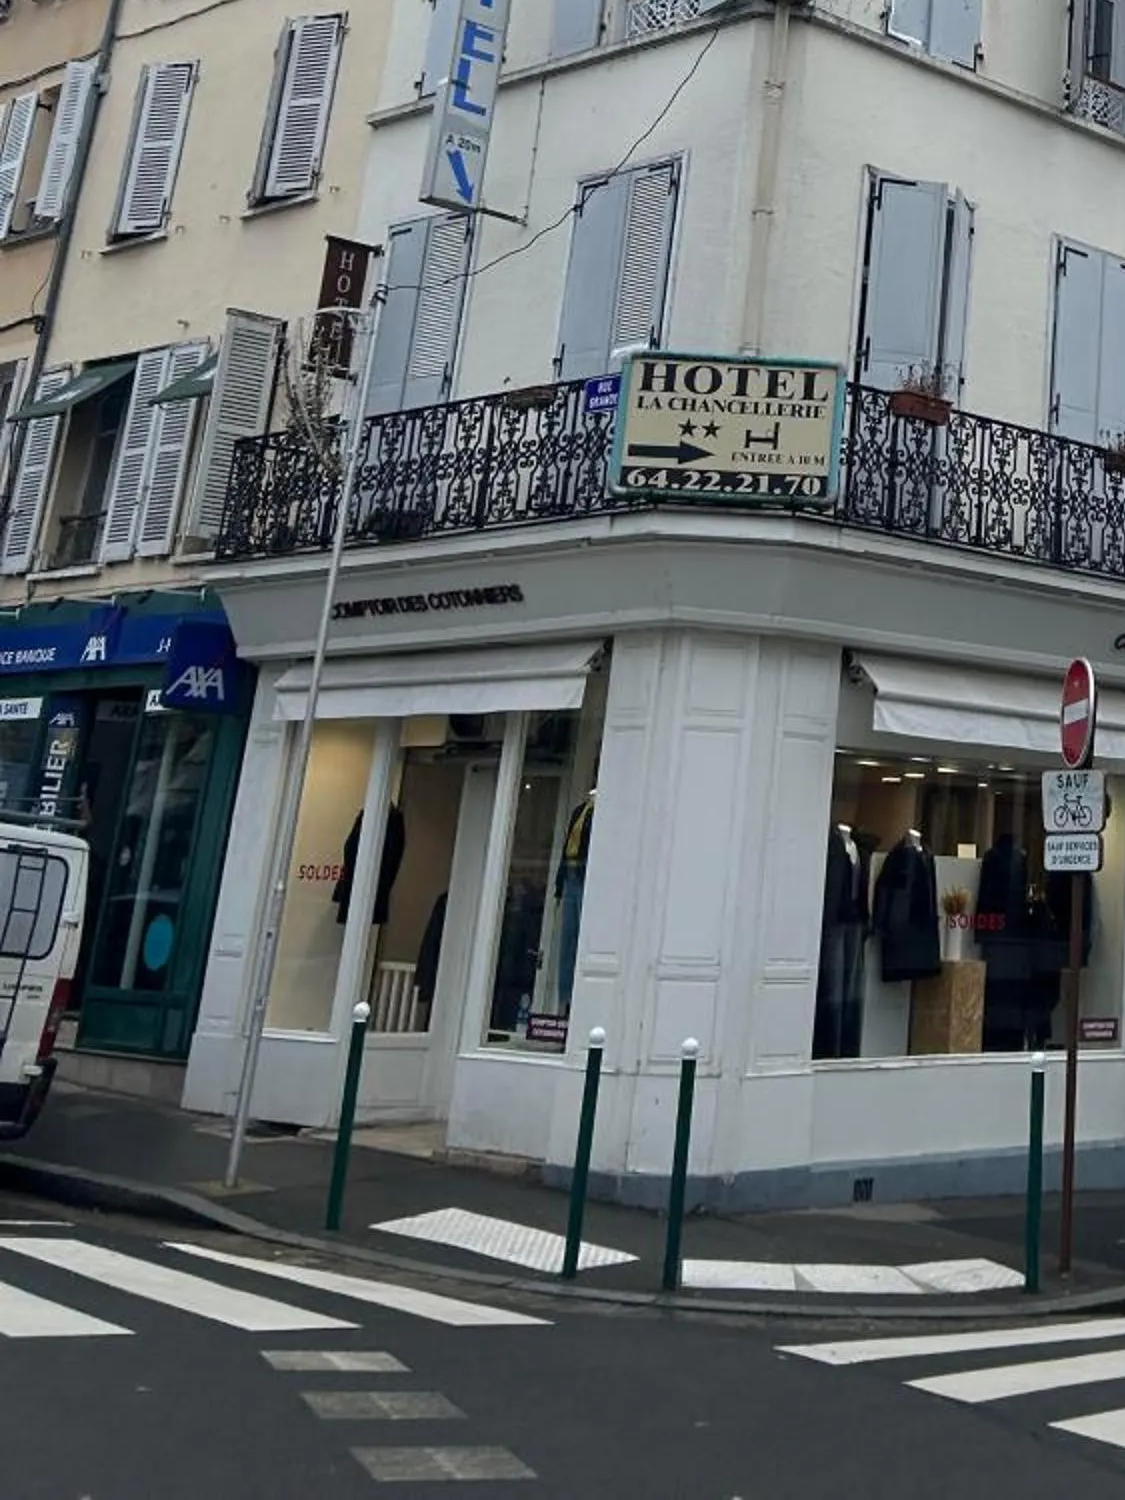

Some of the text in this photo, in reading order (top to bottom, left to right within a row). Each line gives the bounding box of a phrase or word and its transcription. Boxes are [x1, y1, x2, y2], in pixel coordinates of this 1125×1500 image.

[637, 361, 829, 402] HOTEL
[636, 395, 827, 420] LA CHANCELLERIE
[626, 469, 821, 496] 64.22.21.70
[79, 635, 107, 663] AXA
[165, 665, 225, 700] AXA
[38, 739, 71, 817] BILIER
[1056, 773, 1089, 789] SAUF
